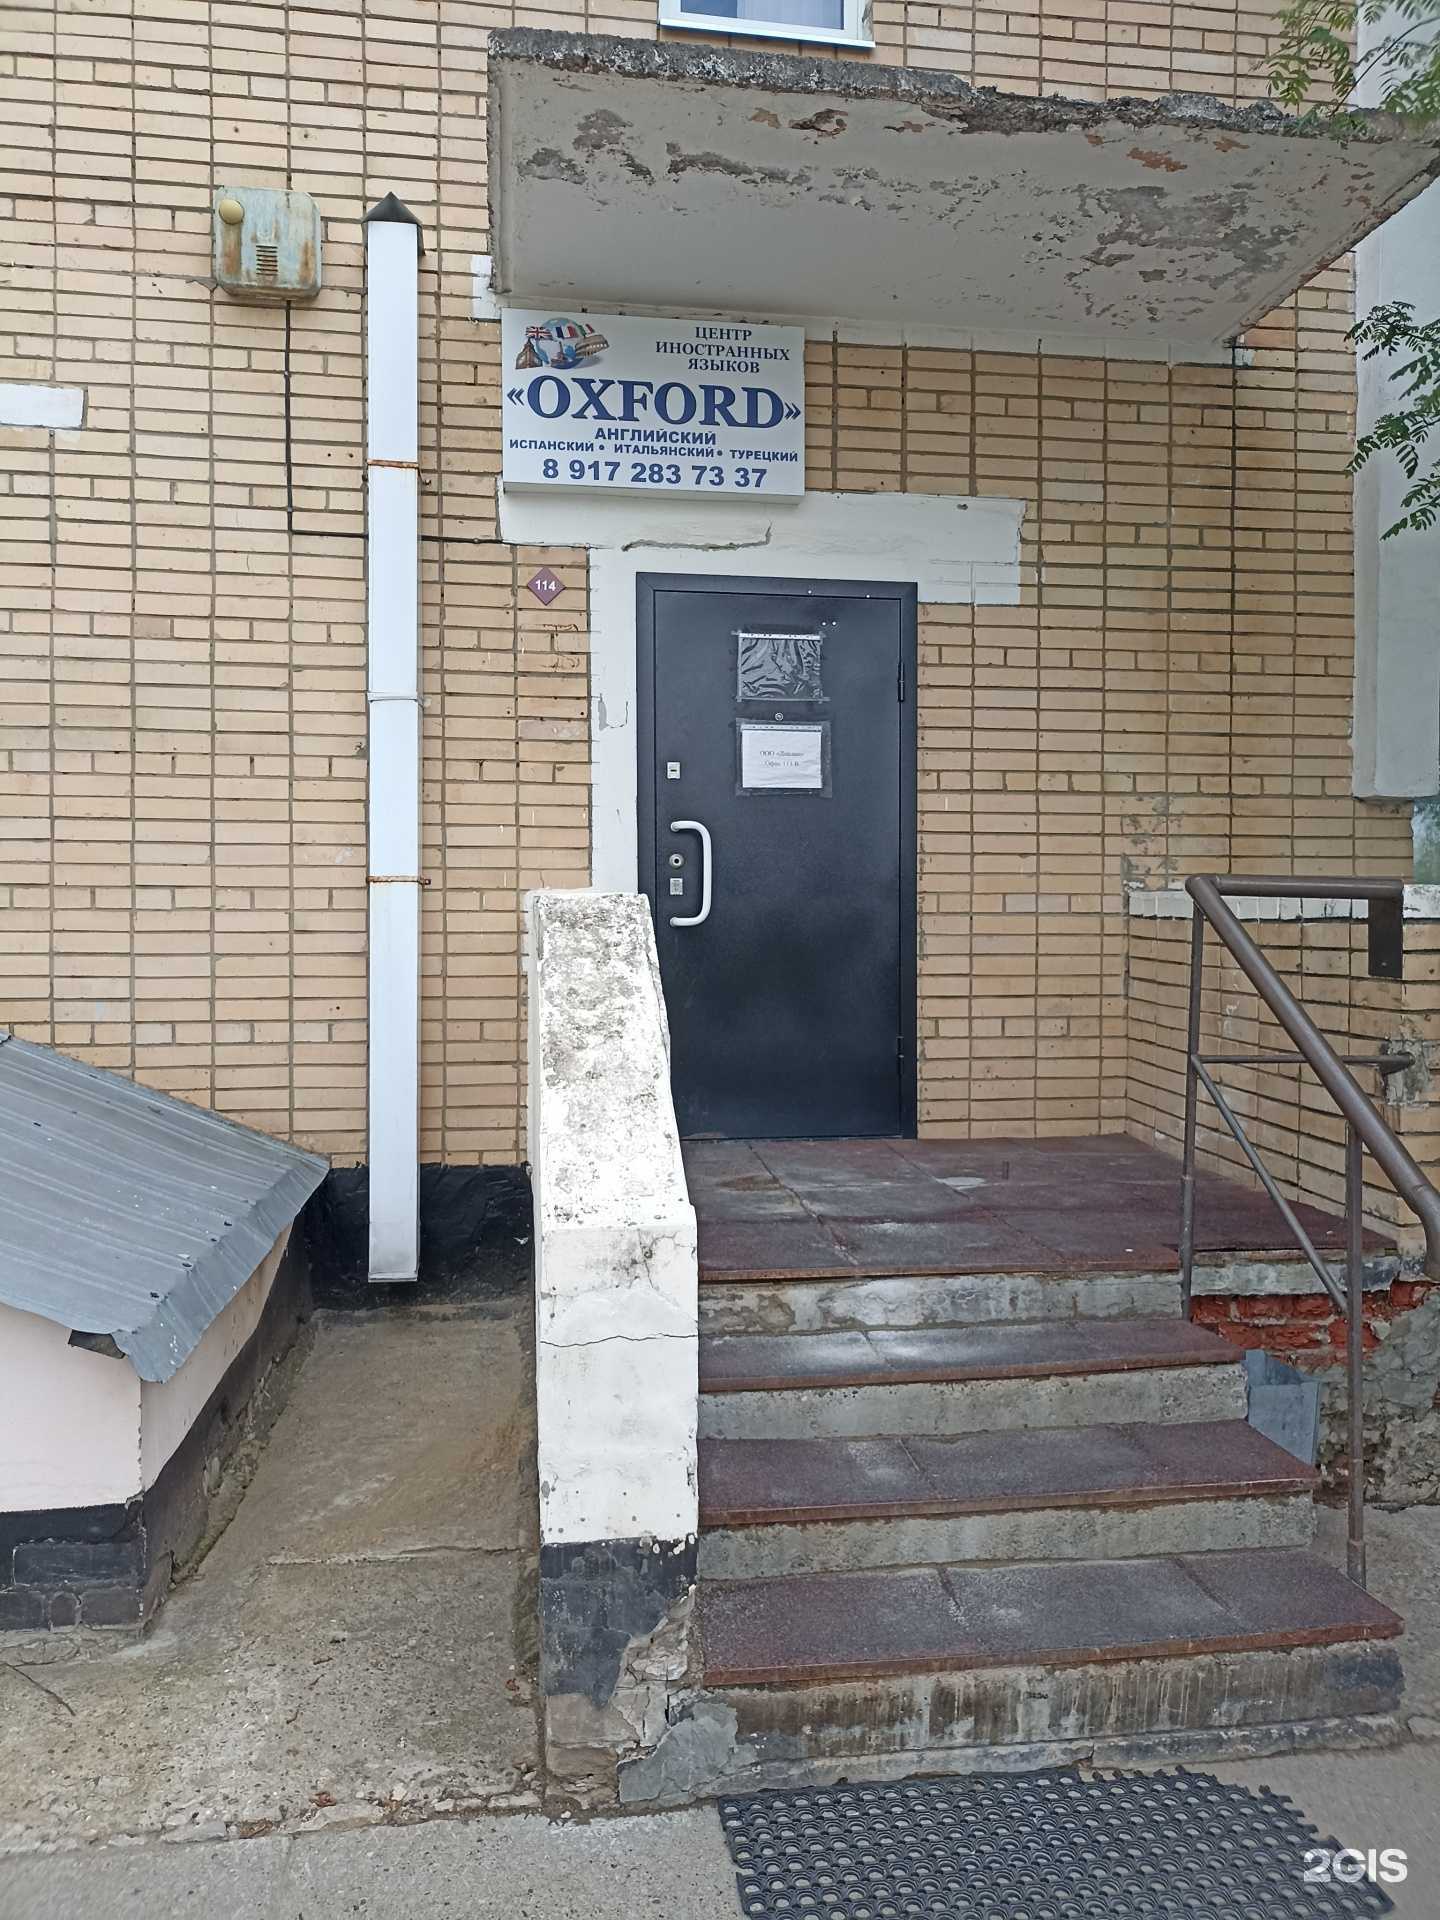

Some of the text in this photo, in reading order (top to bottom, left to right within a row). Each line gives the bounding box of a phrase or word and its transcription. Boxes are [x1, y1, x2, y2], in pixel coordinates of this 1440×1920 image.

[695, 327, 752, 341] ЦЕНТР
[656, 341, 790, 361] ИНОСТРАННЫХ
[687, 358, 760, 373] ЯЗЫКОВ
[506, 375, 801, 428] «OXFORD»
[595, 427, 717, 445] АНГЛИЙСКИЙ
[509, 439, 798, 462] ИСПАНСКИЙ ИТАЛЬЯНСКИЙ ТУРЕЦКИЙ
[542, 458, 767, 488] 8 917 283 73 37
[535, 580, 556, 591] 114
